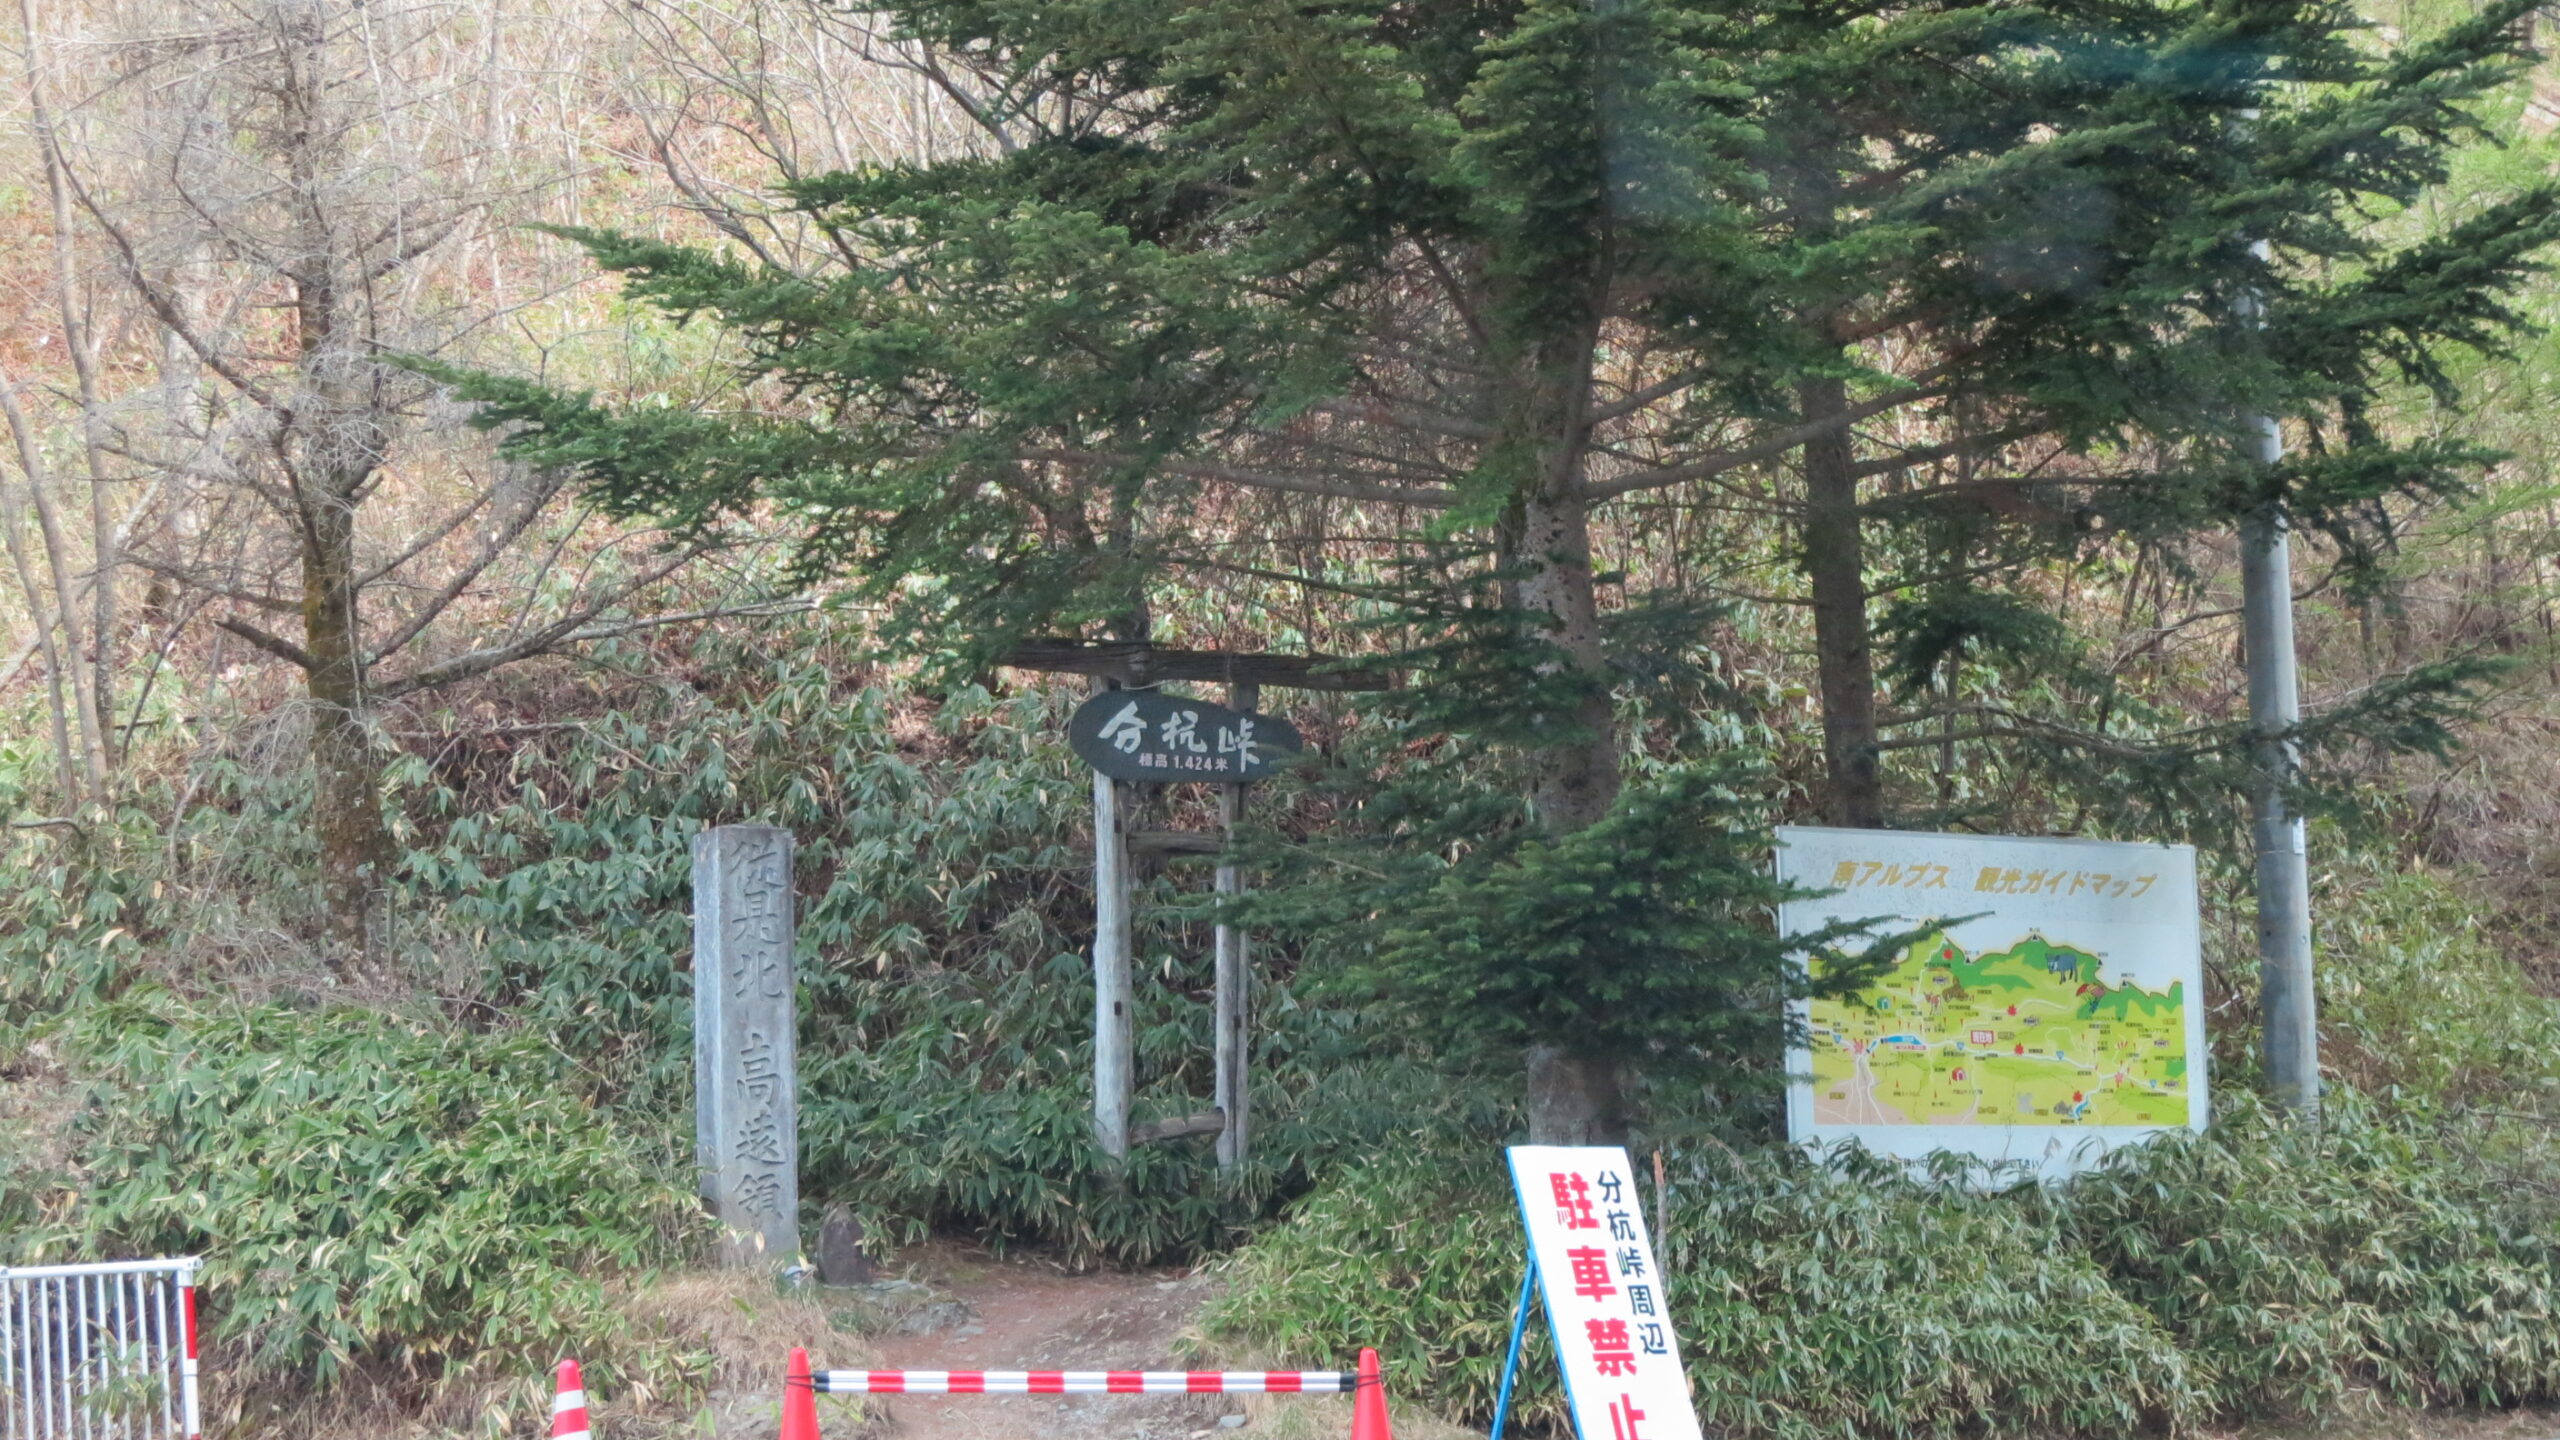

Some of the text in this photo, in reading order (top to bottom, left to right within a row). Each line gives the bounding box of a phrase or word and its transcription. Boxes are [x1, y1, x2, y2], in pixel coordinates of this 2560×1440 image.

[1097, 701, 1260, 773] 分杭峠
[1830, 861, 2159, 898] 南アルプス 観光ガイドマップ
[1549, 1172, 1653, 1440] 駐車禁止
[1597, 1170, 1668, 1354] 分杭峠周辺
